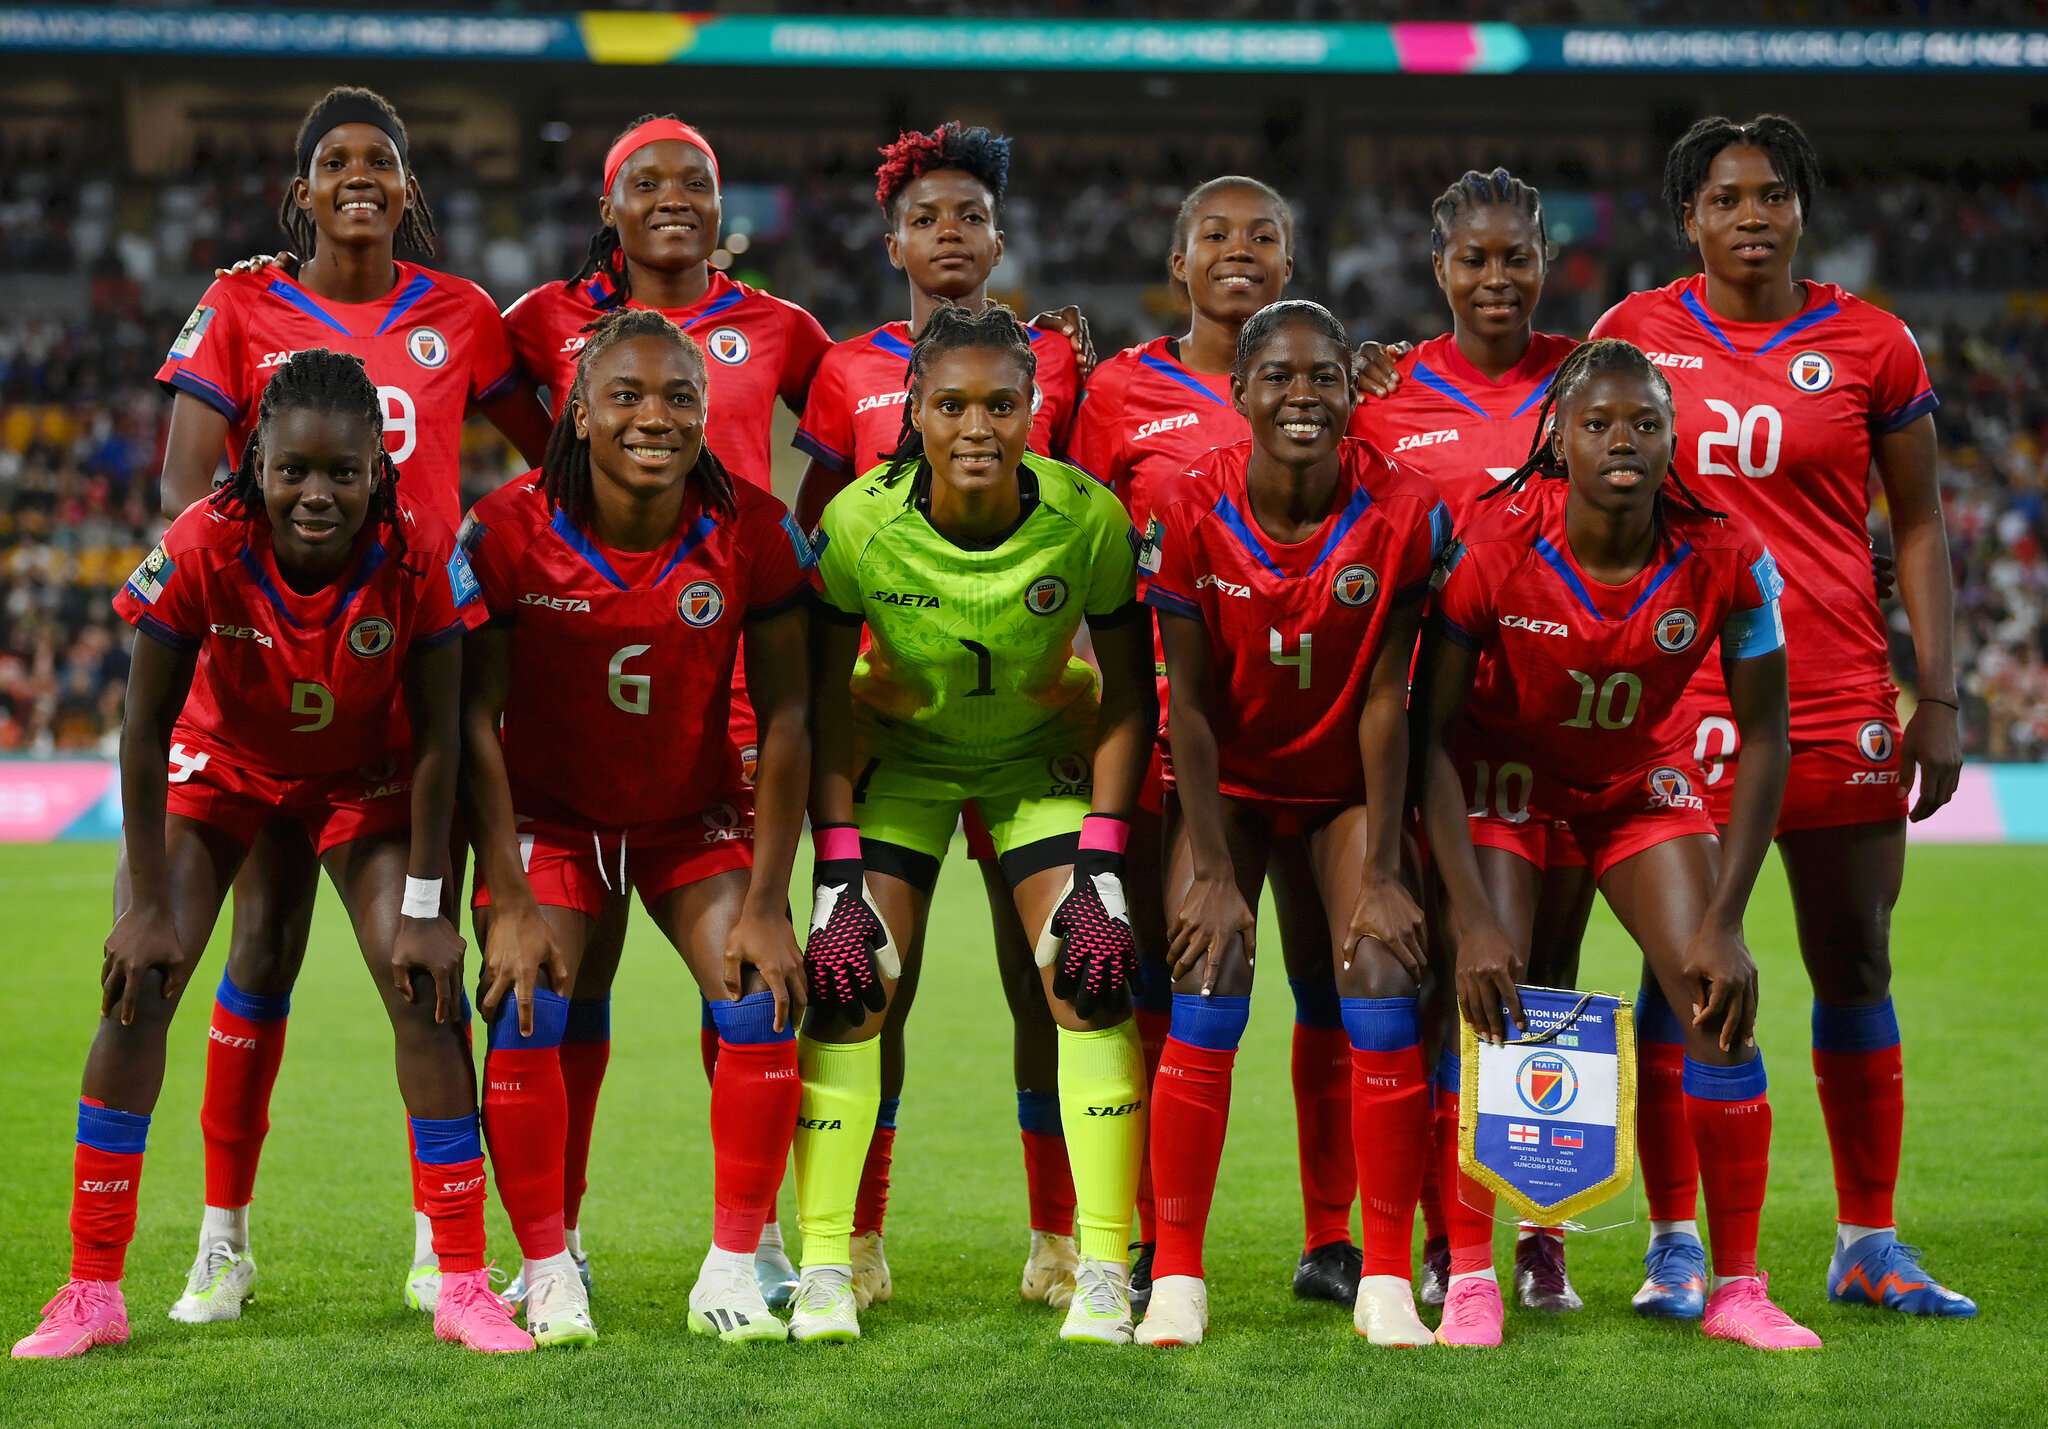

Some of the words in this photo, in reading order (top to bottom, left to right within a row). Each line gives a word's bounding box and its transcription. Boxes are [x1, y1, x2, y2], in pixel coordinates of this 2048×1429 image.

[1132, 412, 1200, 441] SAETA
[1698, 399, 1783, 478] 20
[1393, 429, 1459, 453] SAETA
[870, 591, 940, 608] SAETA
[1196, 575, 1251, 599] SAETA
[519, 593, 591, 612] SAETA
[210, 623, 273, 649] SAETA
[1499, 615, 1568, 638] SAETA
[958, 639, 996, 698] 1
[1270, 627, 1311, 689] 4
[608, 645, 651, 715] 6
[291, 682, 335, 732] 9
[1559, 669, 1642, 730] 10
[1466, 760, 1533, 824] 10
[1535, 1062, 1560, 1070] HAITI
[1547, 1165, 1578, 1173] STADIUM
